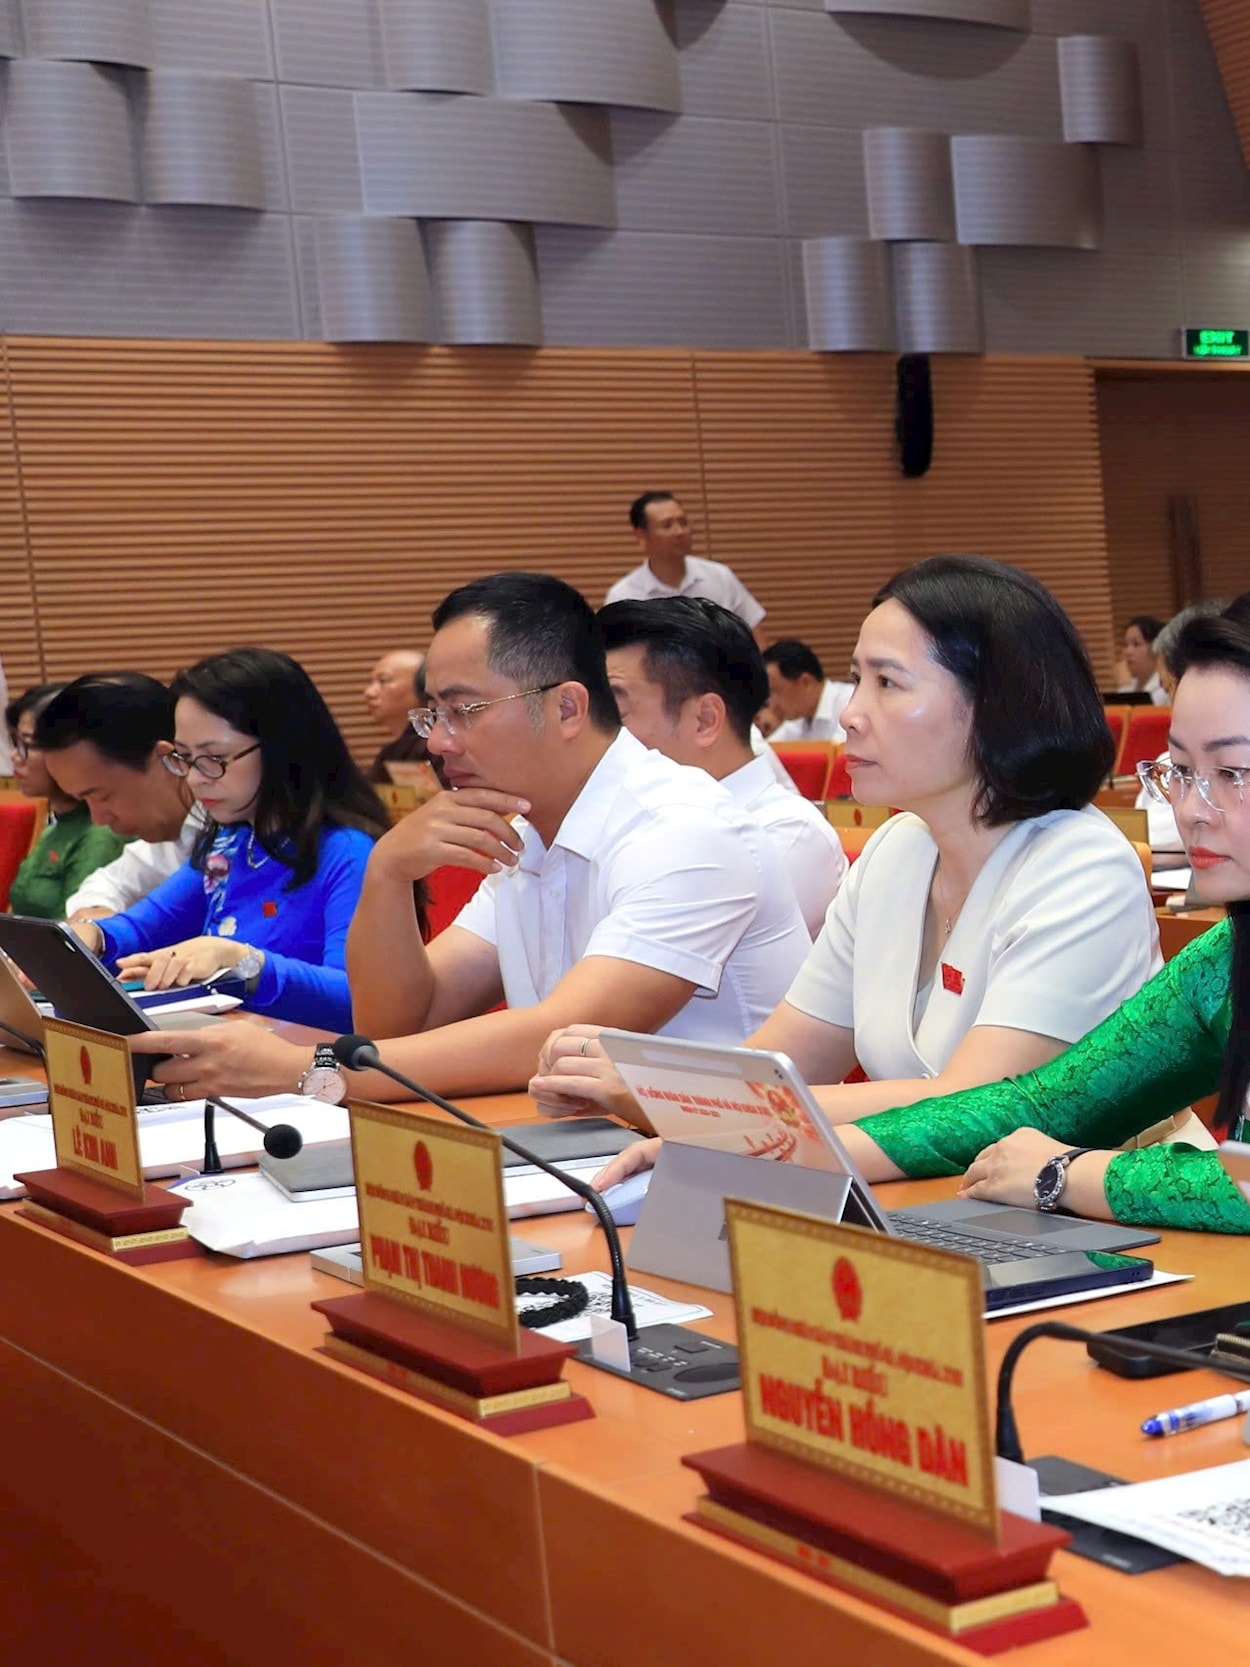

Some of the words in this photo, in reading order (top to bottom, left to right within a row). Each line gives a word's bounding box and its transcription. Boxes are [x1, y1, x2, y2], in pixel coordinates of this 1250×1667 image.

[1200, 330, 1235, 344] EXIT
[759, 1374, 844, 1442] NGUYỄN
[916, 1424, 969, 1488] DÂN
